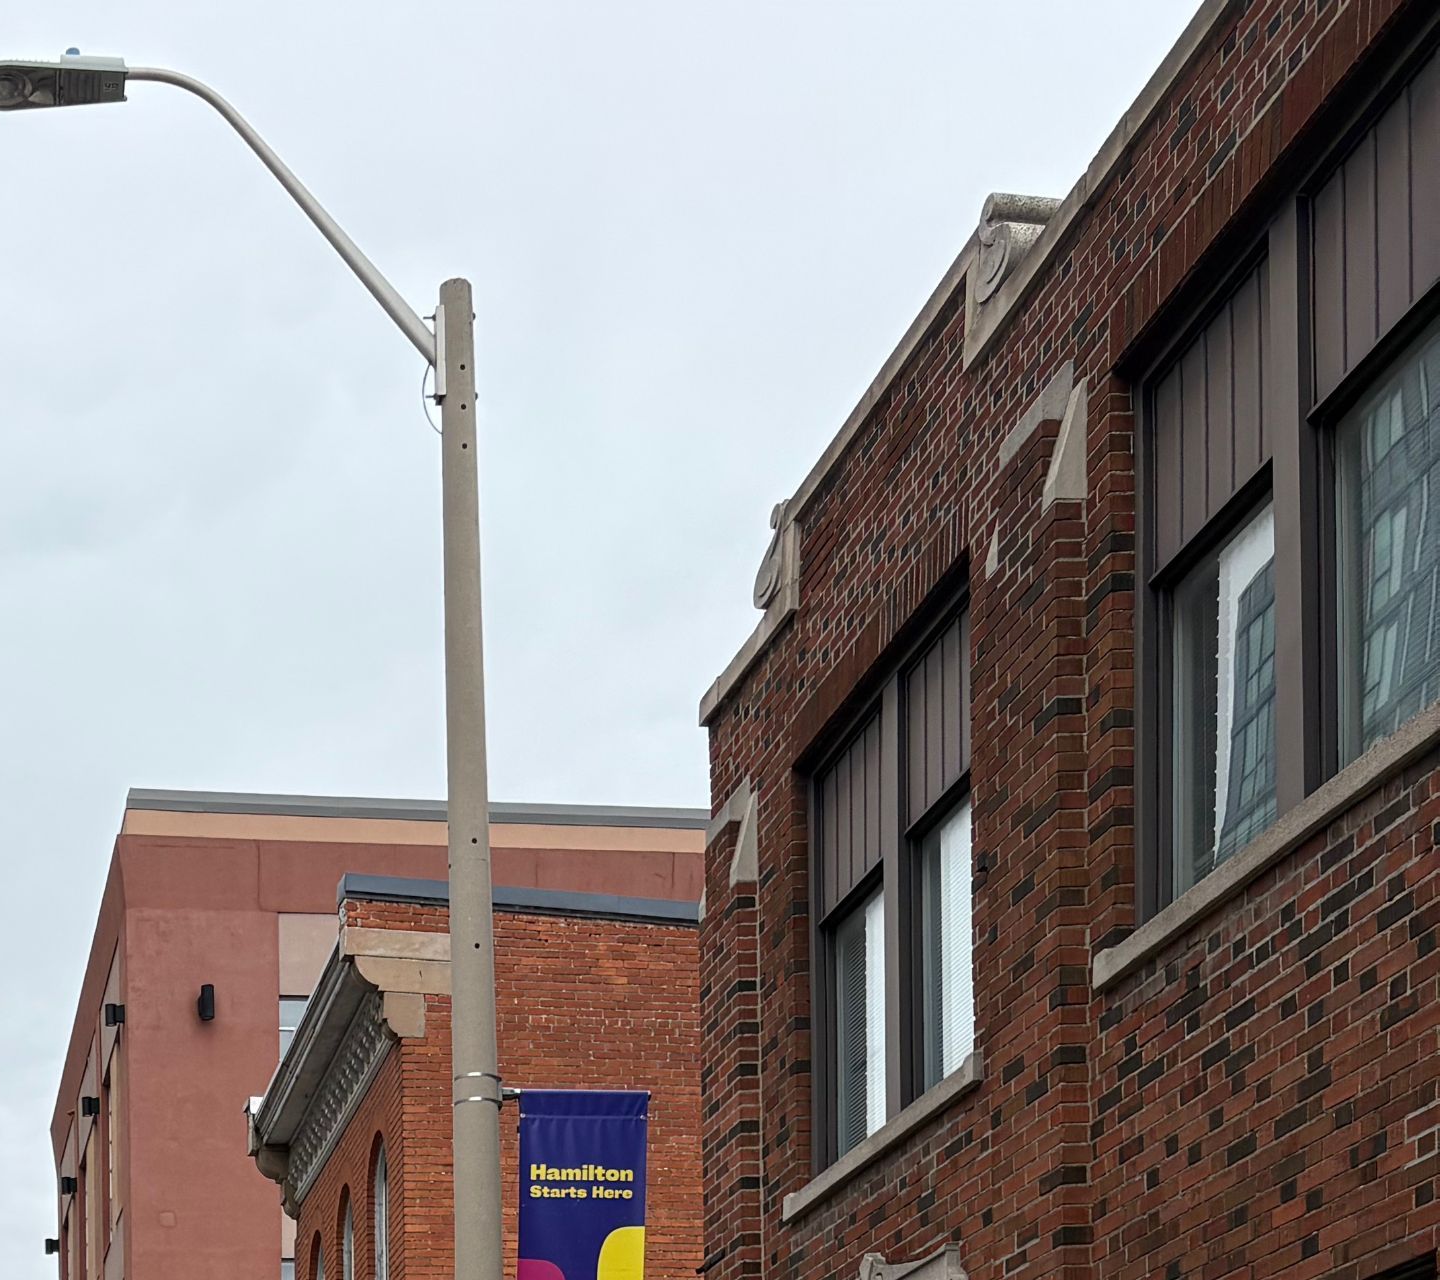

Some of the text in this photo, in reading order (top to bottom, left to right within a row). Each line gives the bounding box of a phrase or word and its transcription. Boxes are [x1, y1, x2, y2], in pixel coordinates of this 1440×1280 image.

[530, 1164, 634, 1181] Hamilton
[529, 1185, 633, 1199] Starts Here
